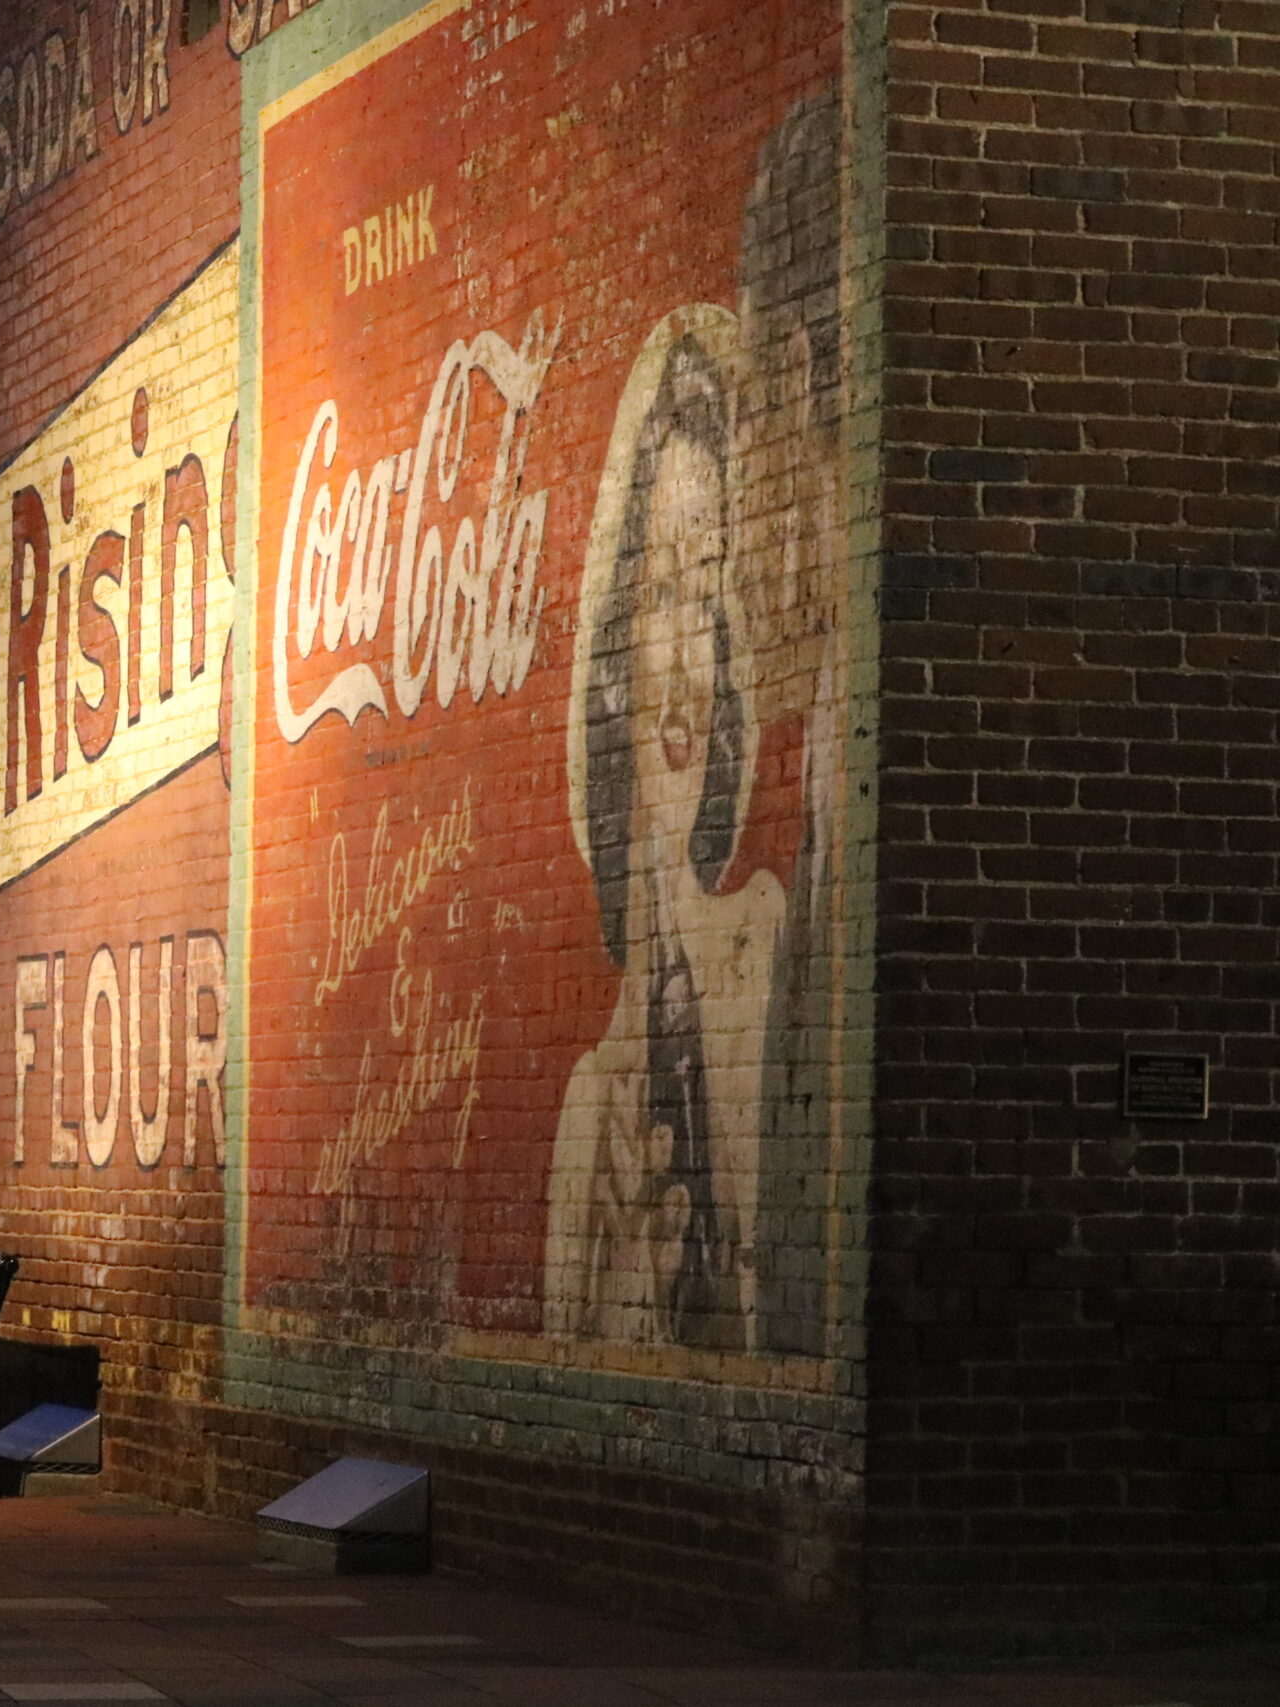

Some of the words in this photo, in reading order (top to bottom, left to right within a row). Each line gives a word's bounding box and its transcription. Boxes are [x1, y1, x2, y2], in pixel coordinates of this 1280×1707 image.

[111, 0, 171, 136] OR
[342, 184, 439, 296] DRINK
[272, 304, 566, 744] Coca-Cola
[315, 773, 476, 1007] Delicious
[13, 928, 227, 1172] FLOUR
